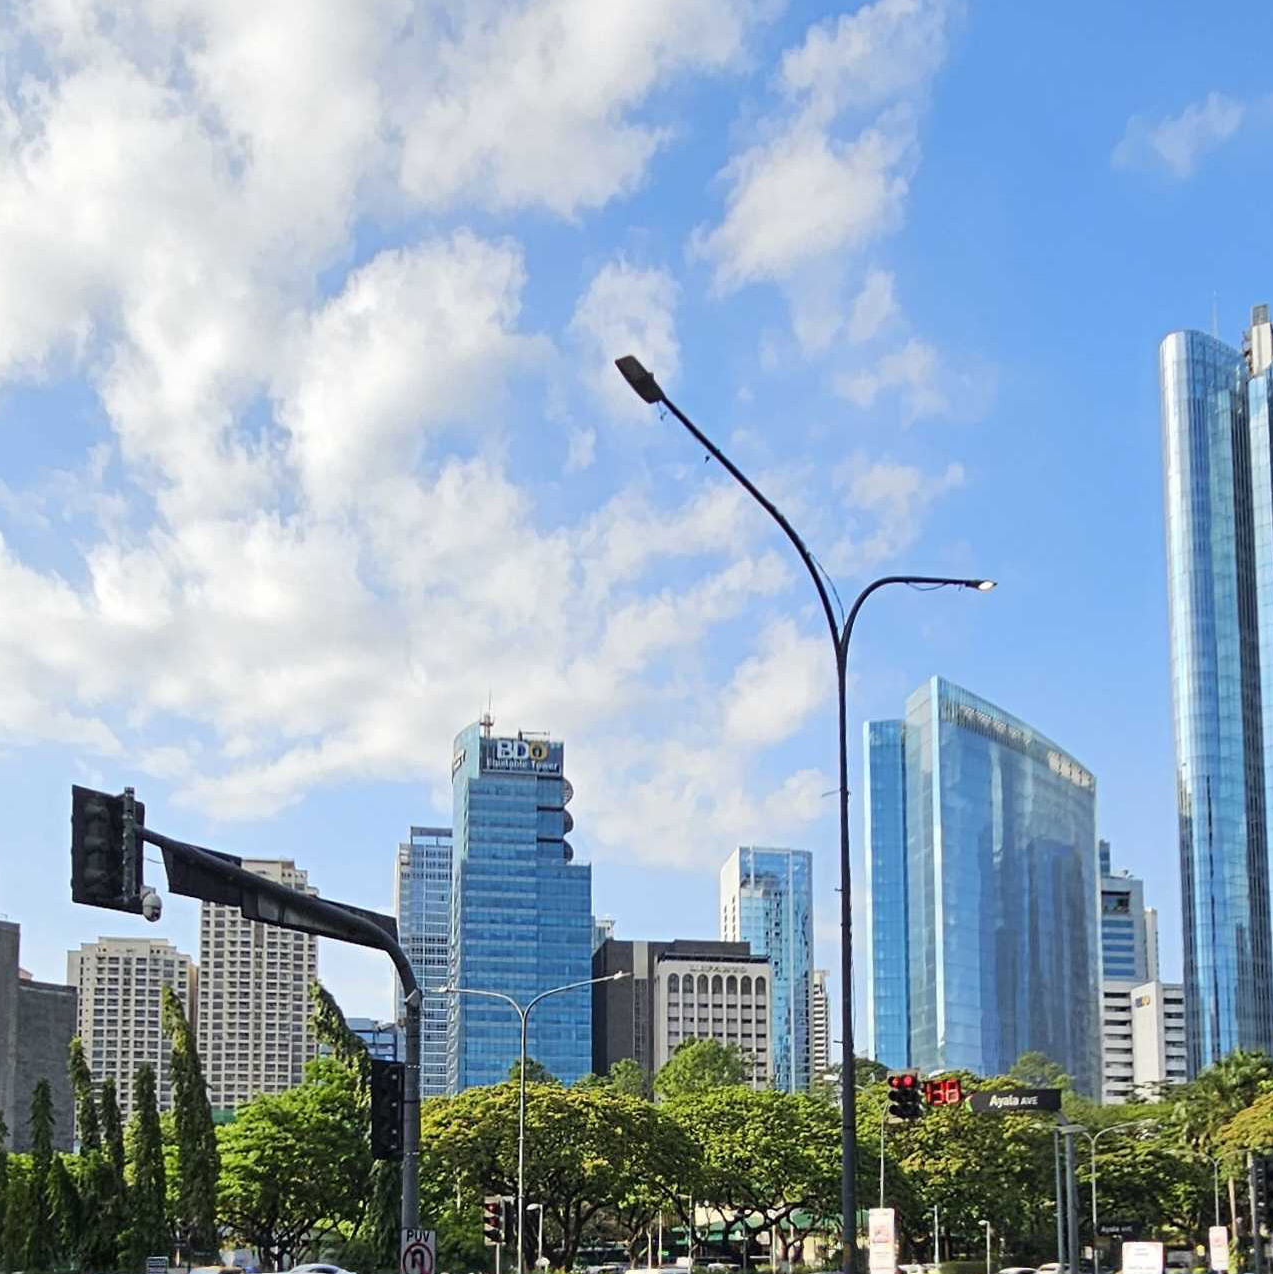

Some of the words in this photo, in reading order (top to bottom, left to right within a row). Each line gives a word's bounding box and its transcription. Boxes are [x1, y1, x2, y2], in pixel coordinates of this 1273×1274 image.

[497, 740, 548, 761] BDO
[989, 1094, 1019, 1108] Ayala
[1020, 1095, 1038, 1105] AVE
[407, 1230, 431, 1242] PUV
